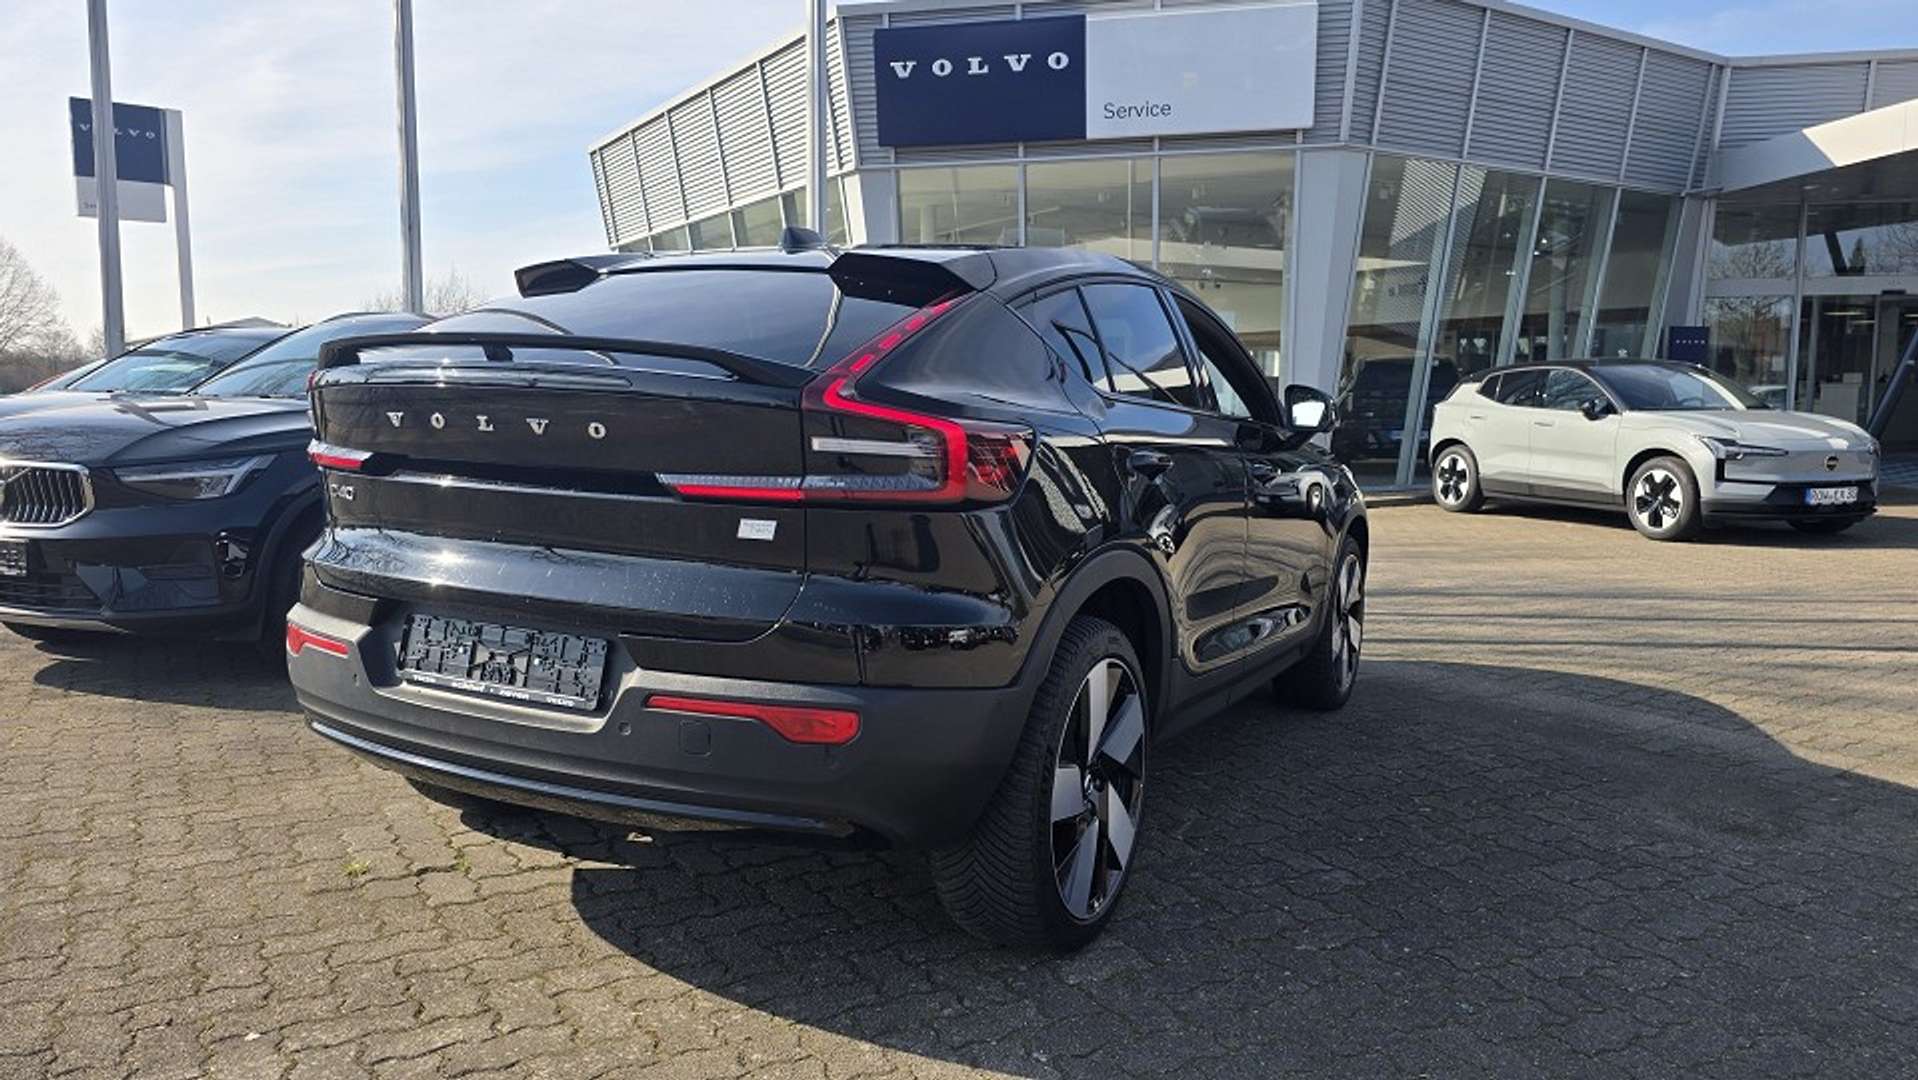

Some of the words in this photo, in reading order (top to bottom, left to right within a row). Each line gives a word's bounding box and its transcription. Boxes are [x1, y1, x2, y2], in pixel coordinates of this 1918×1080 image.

[890, 51, 1069, 79] VOLVO
[1103, 100, 1171, 119] Service
[79, 123, 156, 140] VLVO
[386, 411, 607, 440] VOLVO
